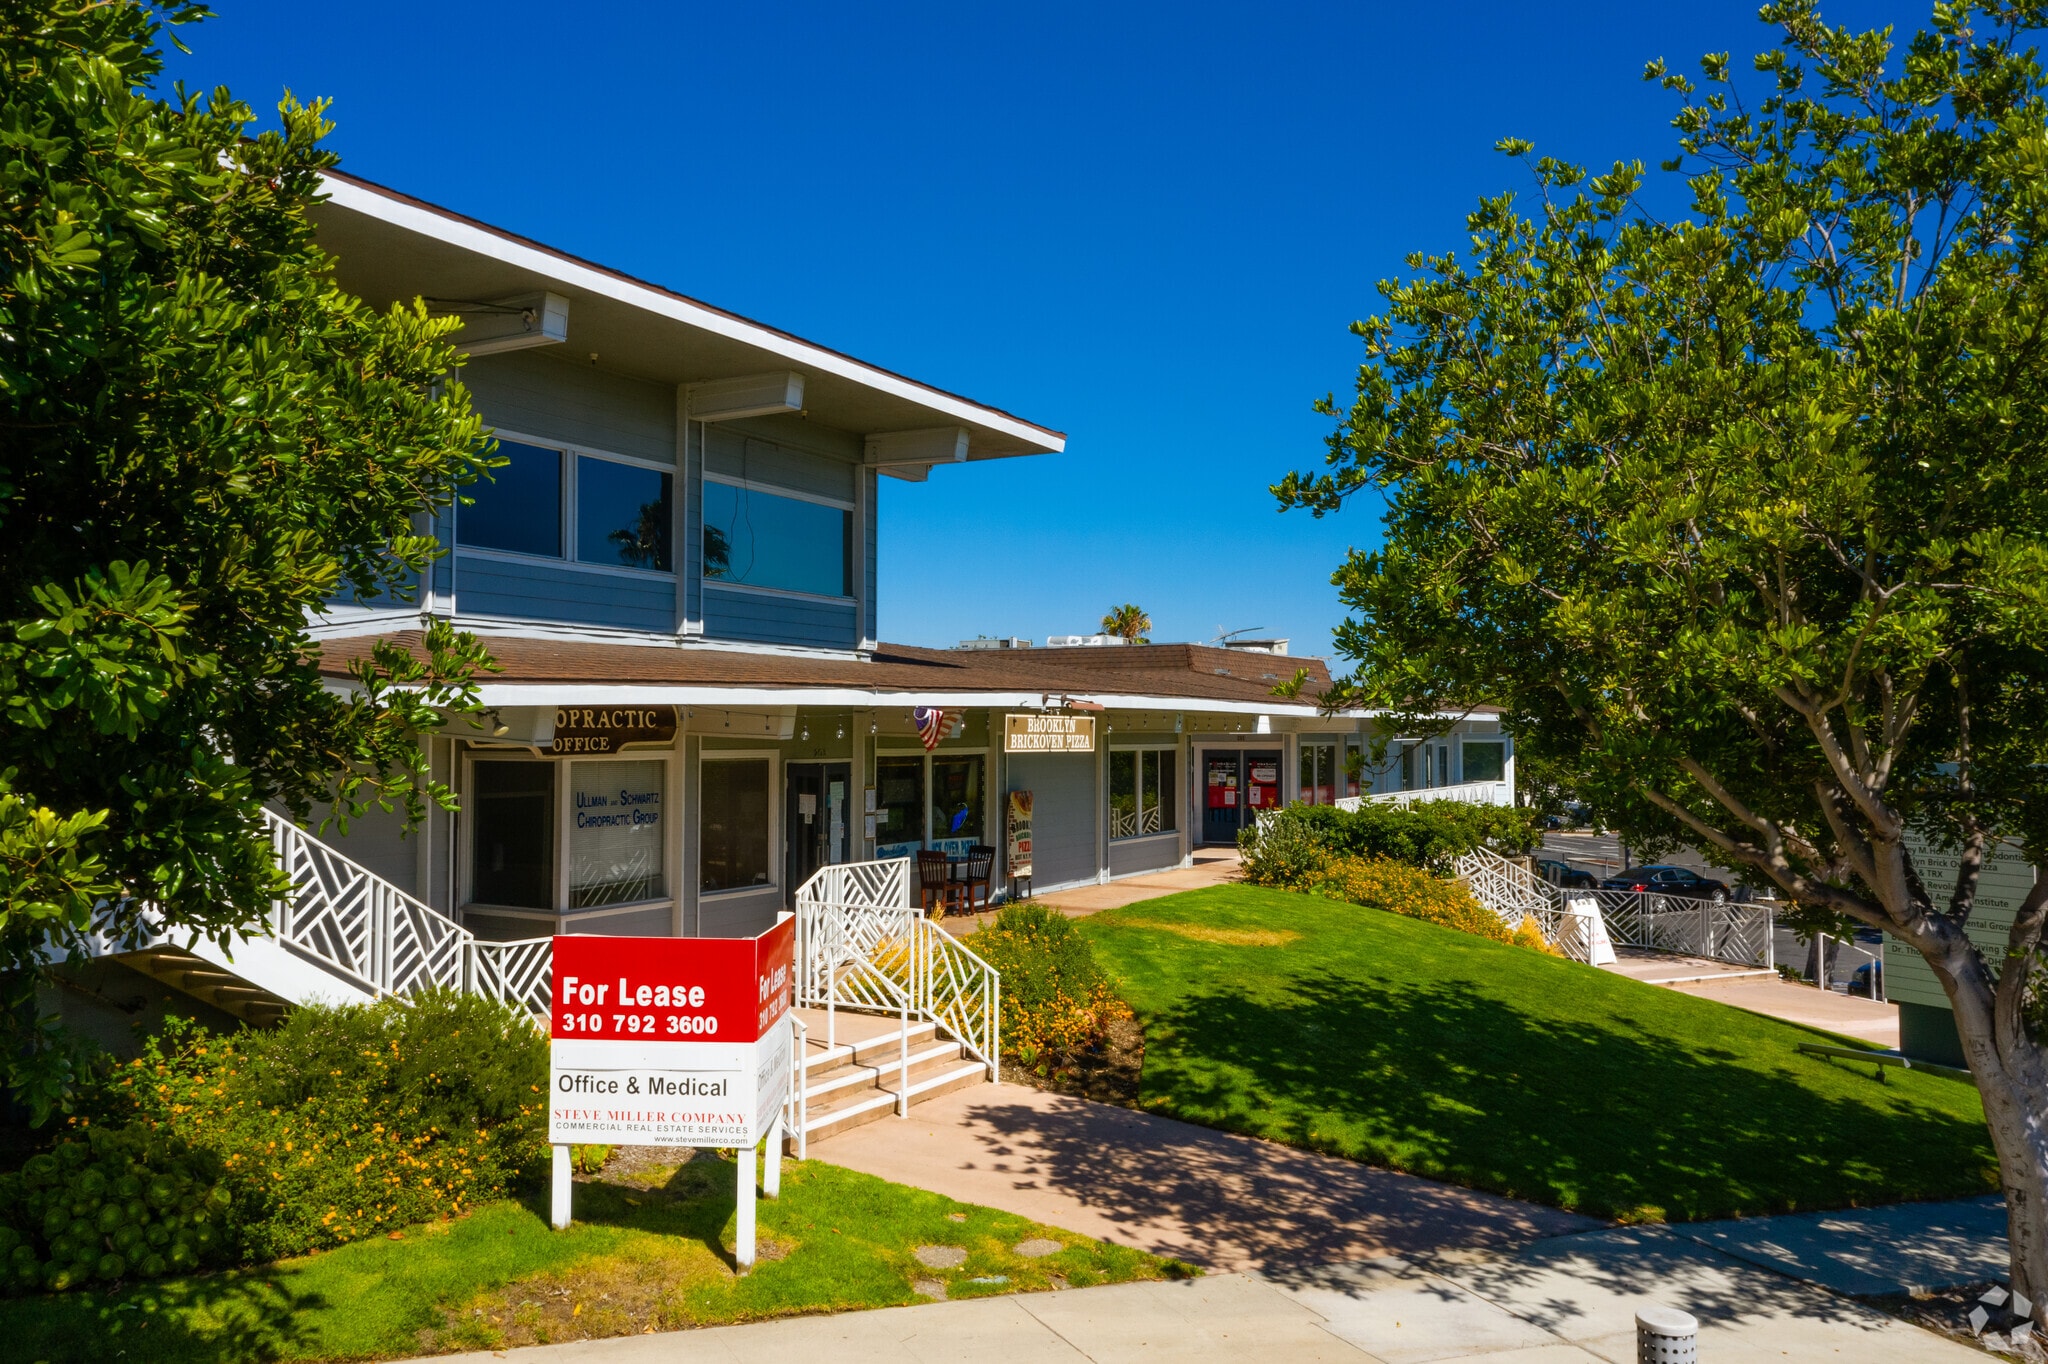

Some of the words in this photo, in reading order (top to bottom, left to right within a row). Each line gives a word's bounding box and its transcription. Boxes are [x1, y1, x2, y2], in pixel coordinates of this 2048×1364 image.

[555, 709, 657, 729] OPRACTIC
[1027, 717, 1076, 733] BROOKLYN
[552, 736, 610, 752] OFFICE
[1066, 734, 1090, 749] PIZZA
[1927, 858, 1948, 868] Brick
[1927, 870, 1943, 878] TRX
[1891, 945, 1904, 953] Dr.
[562, 976, 609, 1006] For
[618, 977, 706, 1008] Lease
[759, 972, 770, 1004] For
[562, 1013, 603, 1032] 310
[612, 1014, 656, 1033] 792
[666, 1015, 718, 1034] 3600
[558, 1074, 619, 1094] Office
[626, 1076, 640, 1095] &
[648, 1076, 728, 1097] Medical
[554, 1108, 601, 1121] STEVE
[607, 1110, 666, 1122] MILLER
[671, 1112, 746, 1124] COMPANY
[555, 1121, 622, 1131] COMMERCIAL
[626, 1123, 652, 1132] REAL
[656, 1124, 694, 1133] ESTATE
[698, 1125, 748, 1135] SERVICES
[654, 1135, 748, 1145] www.stevemillerco.com
